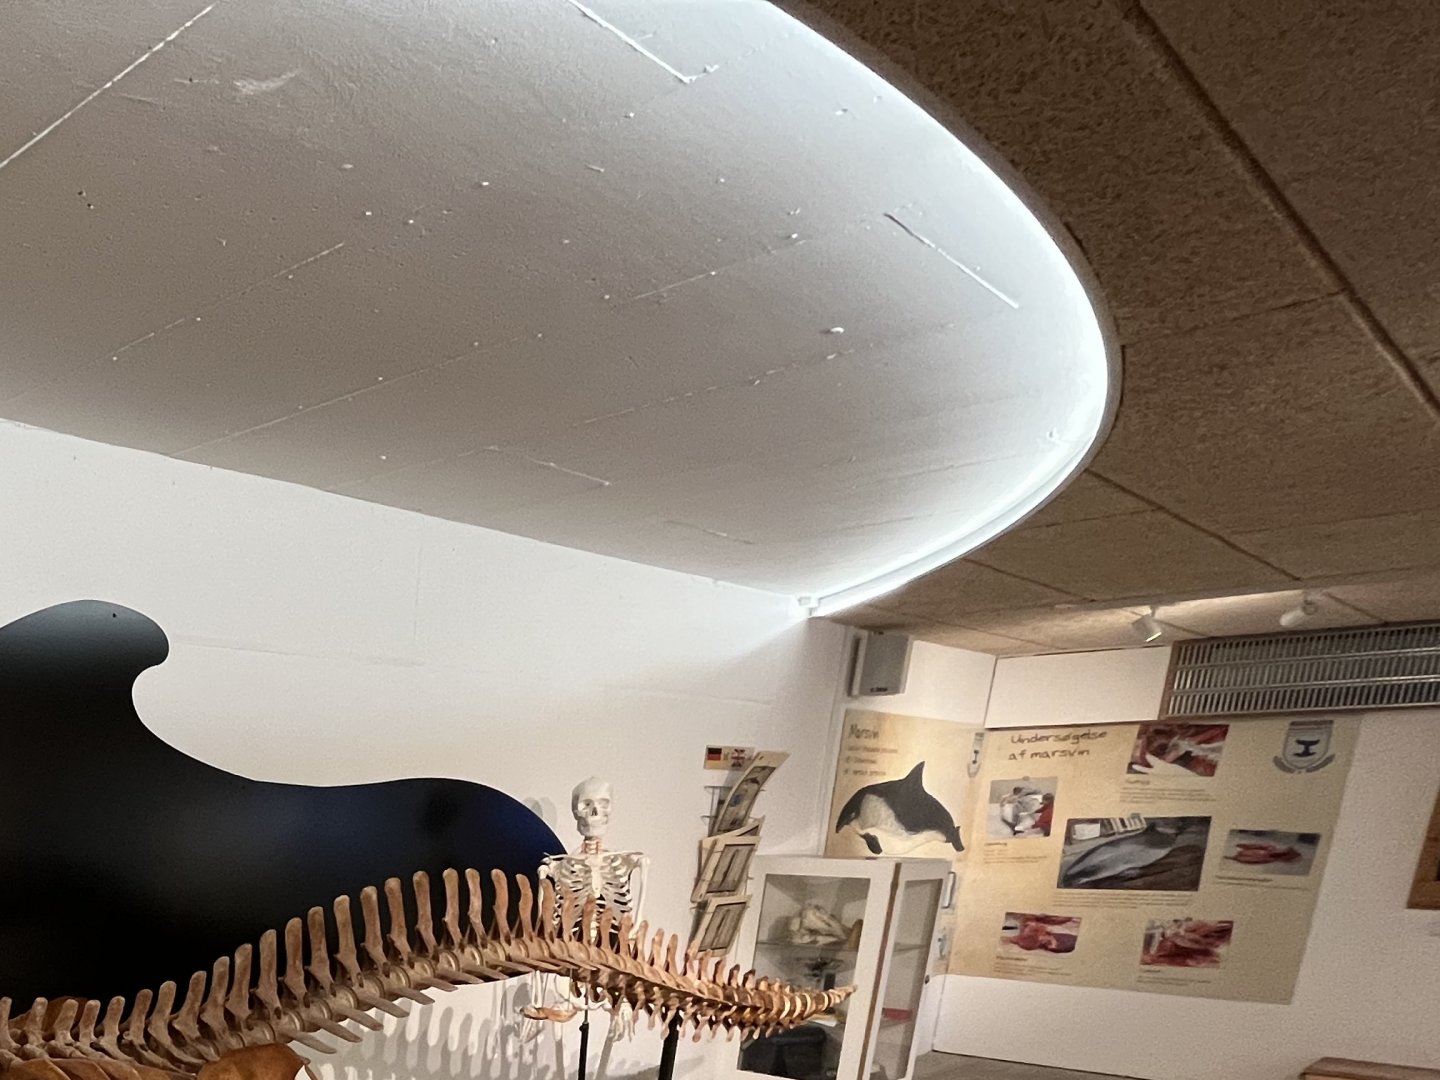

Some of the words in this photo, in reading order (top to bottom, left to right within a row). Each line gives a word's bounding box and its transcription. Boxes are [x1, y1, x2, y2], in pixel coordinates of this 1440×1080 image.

[1010, 728, 1108, 745] Undersøgelse
[1008, 749, 1027, 761] af
[1030, 748, 1090, 760] marsvin
